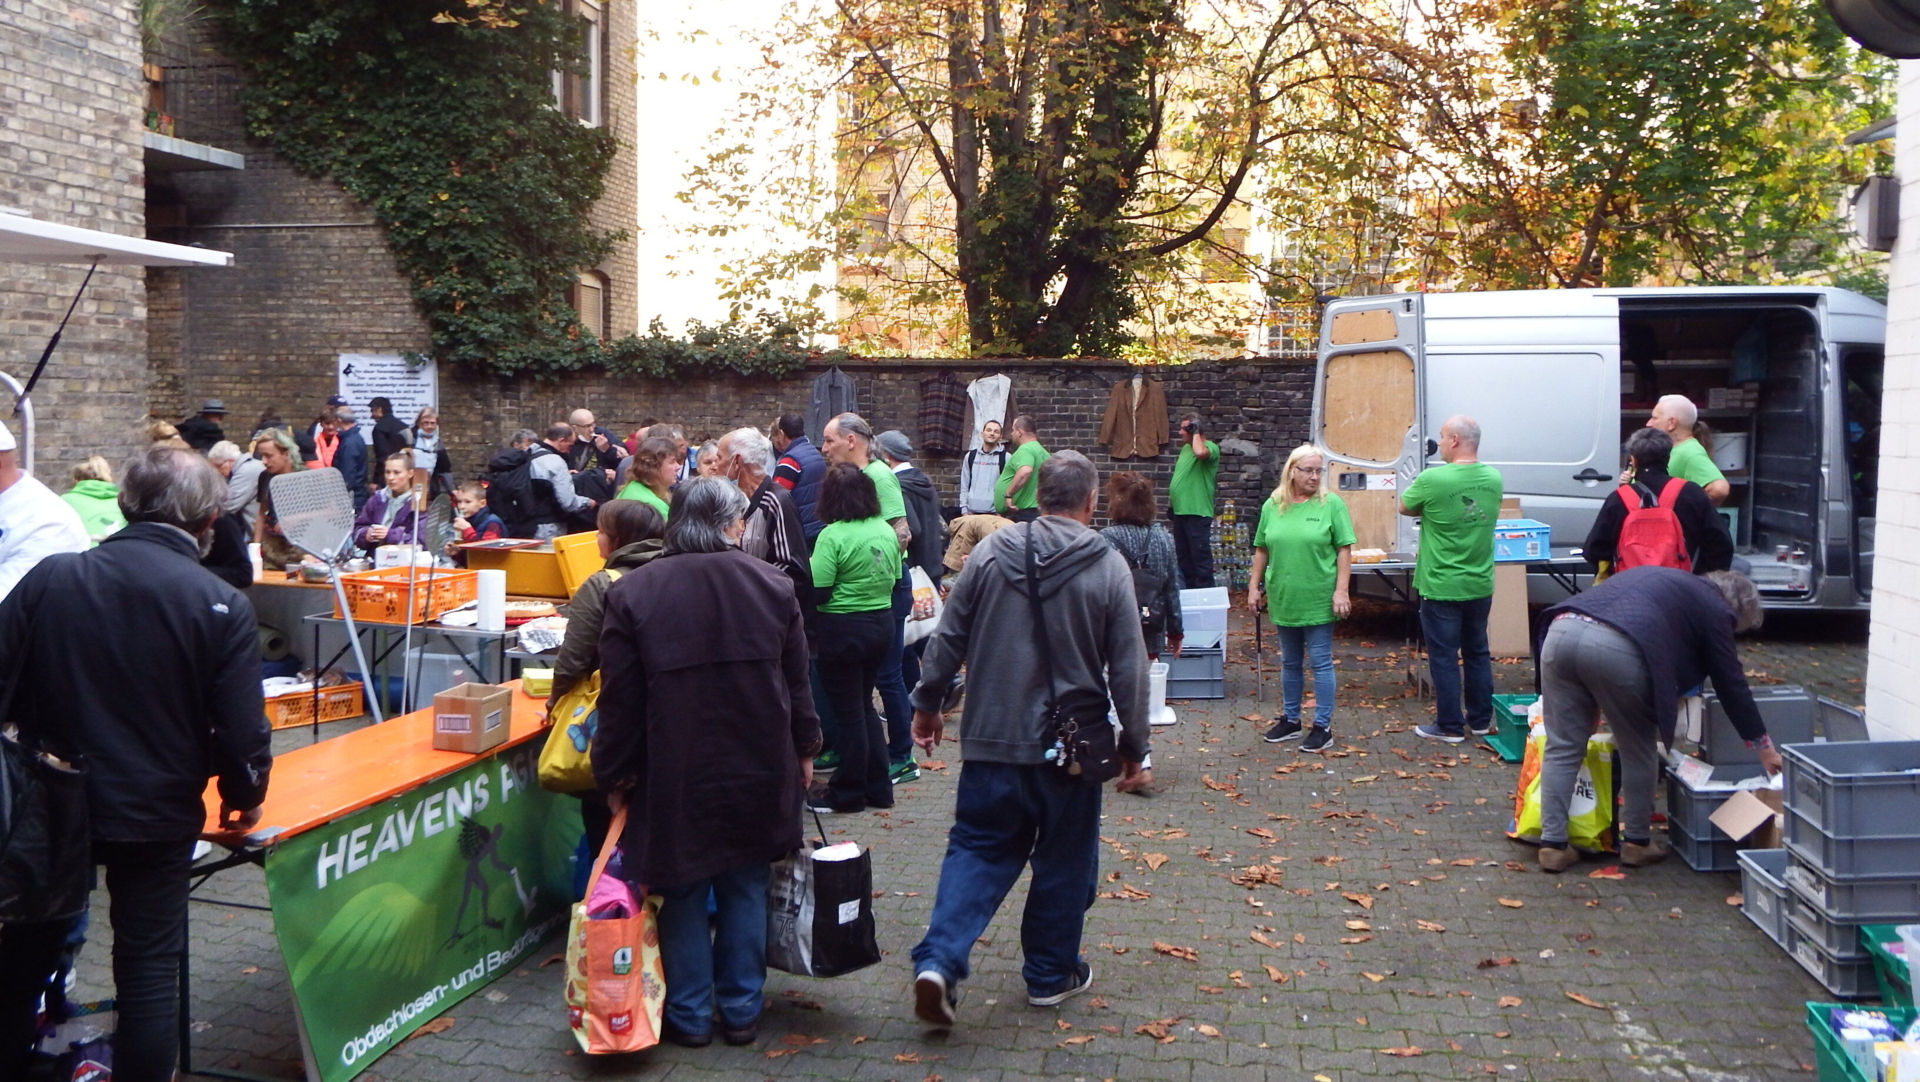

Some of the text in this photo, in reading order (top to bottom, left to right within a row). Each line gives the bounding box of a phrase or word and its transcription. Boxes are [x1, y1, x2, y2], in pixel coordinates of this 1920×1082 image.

[316, 773, 490, 890] HEAVENS
[341, 984, 449, 1067] Obdachlosen-
[450, 957, 485, 991] und
